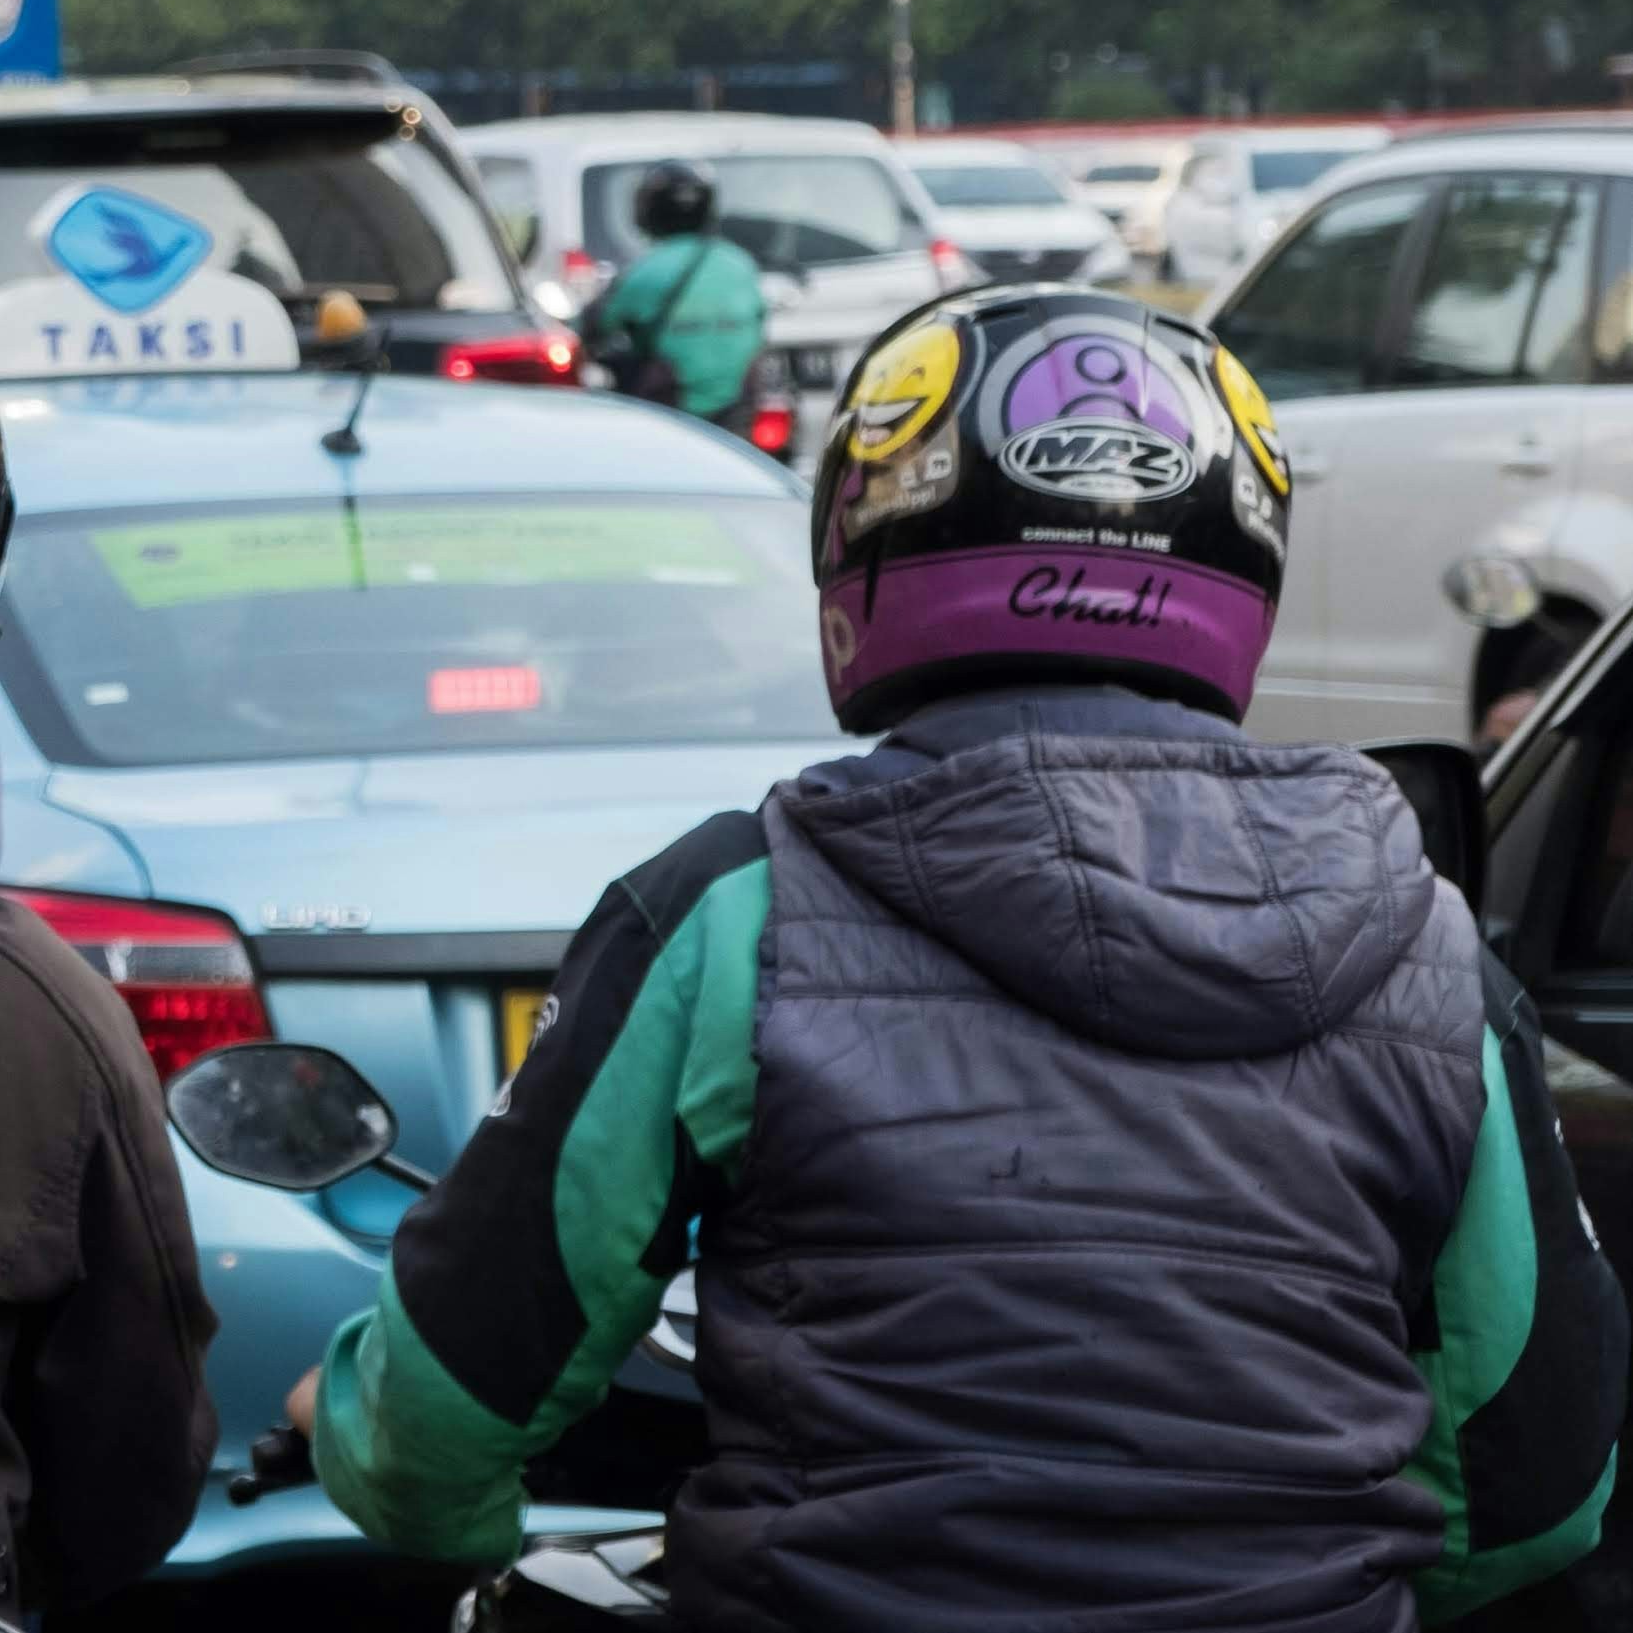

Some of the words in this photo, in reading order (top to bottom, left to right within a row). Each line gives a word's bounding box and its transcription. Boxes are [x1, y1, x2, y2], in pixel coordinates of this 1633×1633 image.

[41, 320, 245, 362] TAKSI
[1021, 526, 1095, 545] connect
[1099, 528, 1128, 548] the
[1132, 531, 1171, 553] LINE
